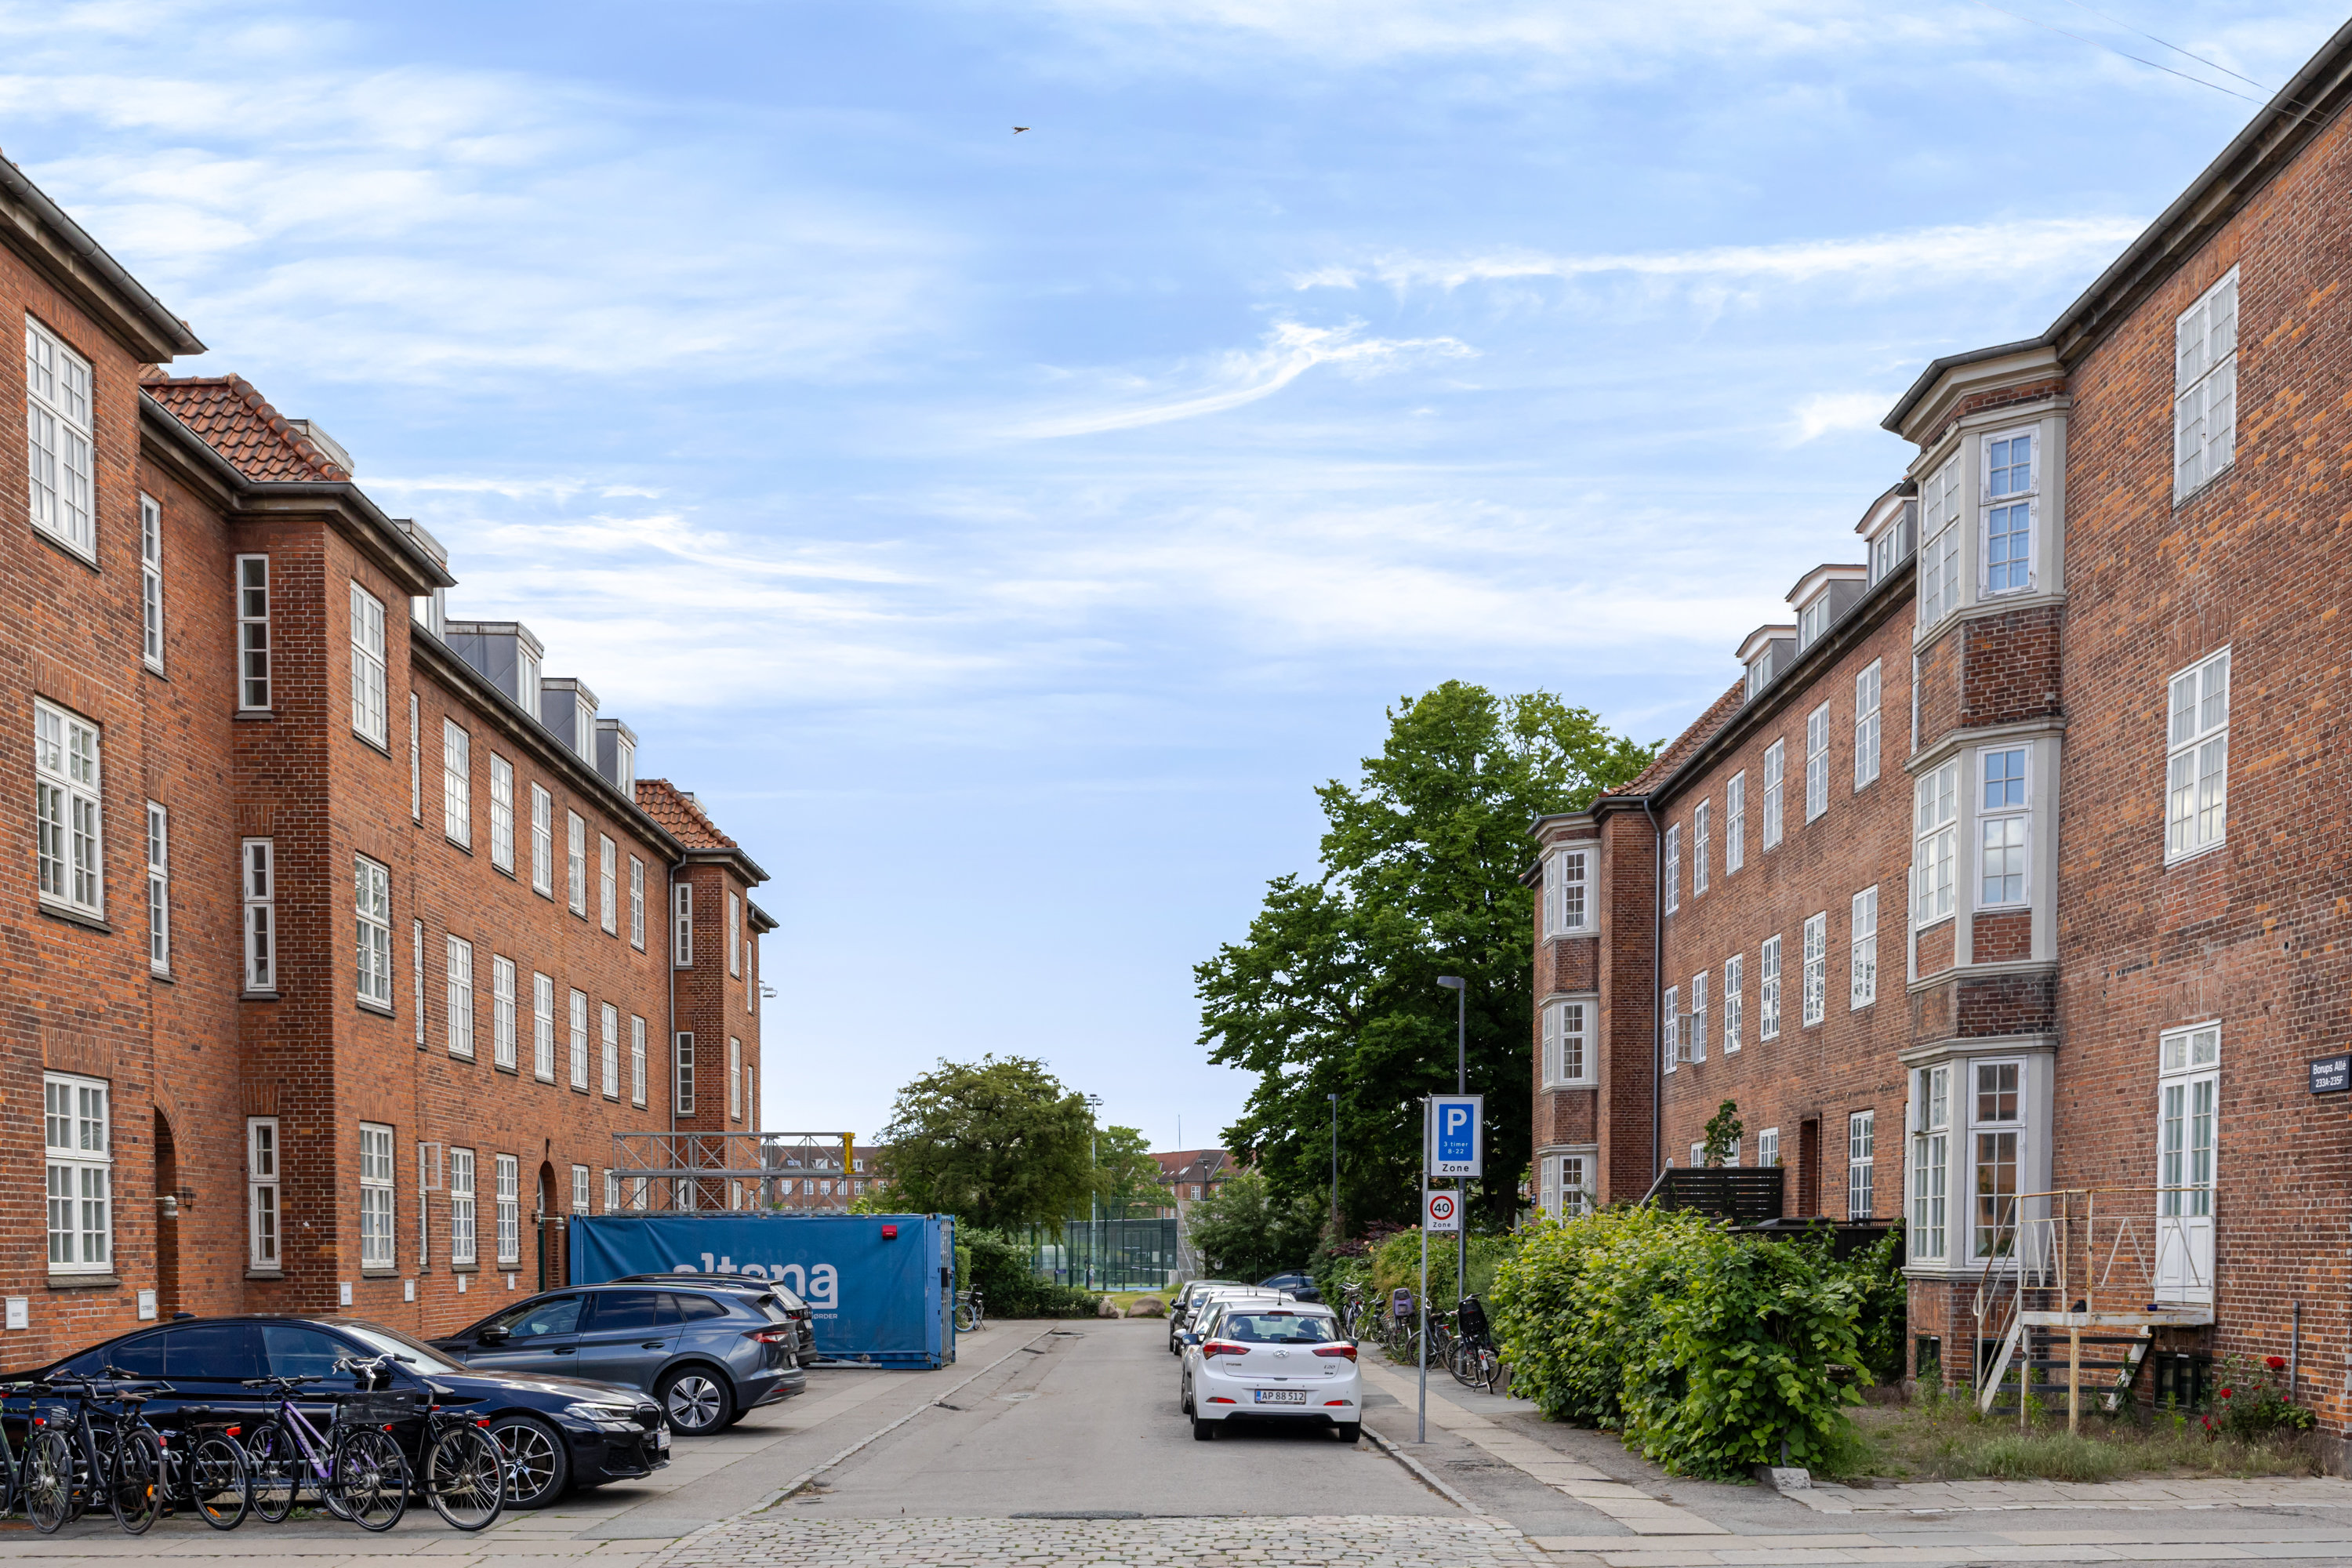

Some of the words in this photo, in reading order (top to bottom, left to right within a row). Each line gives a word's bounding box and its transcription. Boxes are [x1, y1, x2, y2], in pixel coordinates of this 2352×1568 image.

[2313, 1064, 2333, 1075] Borups
[2334, 1060, 2347, 1072] Allé
[2315, 1075, 2343, 1088] 233A-235F
[1447, 1109, 1468, 1136] P
[1434, 1203, 1450, 1213] 40
[673, 1253, 838, 1309] ltna
[1261, 1392, 1274, 1400] AP
[1276, 1392, 1287, 1400] 88
[1288, 1392, 1304, 1401] 512
